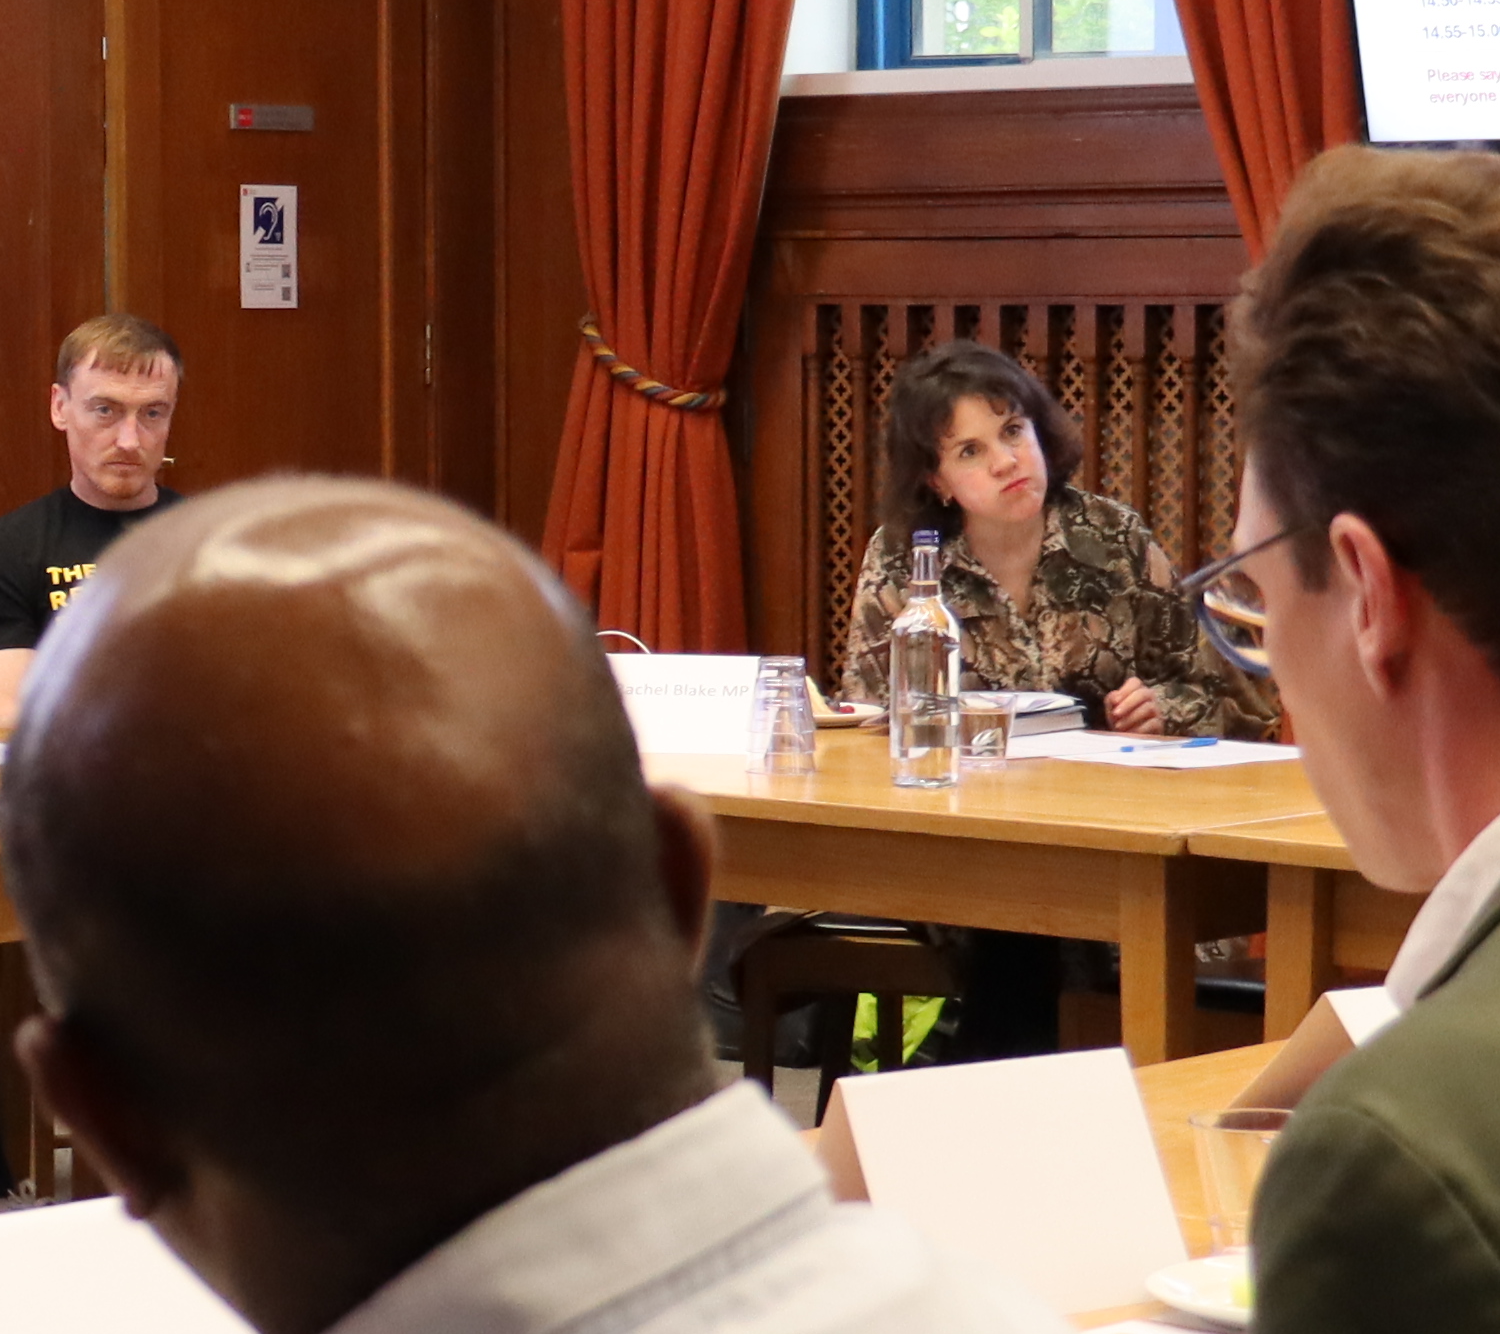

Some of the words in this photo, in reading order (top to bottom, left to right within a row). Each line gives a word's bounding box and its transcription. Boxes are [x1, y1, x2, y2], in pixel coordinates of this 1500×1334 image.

[1426, 68, 1475, 82] Please
[618, 683, 669, 697] achel
[673, 683, 717, 697] Blake
[722, 685, 750, 697] MP
